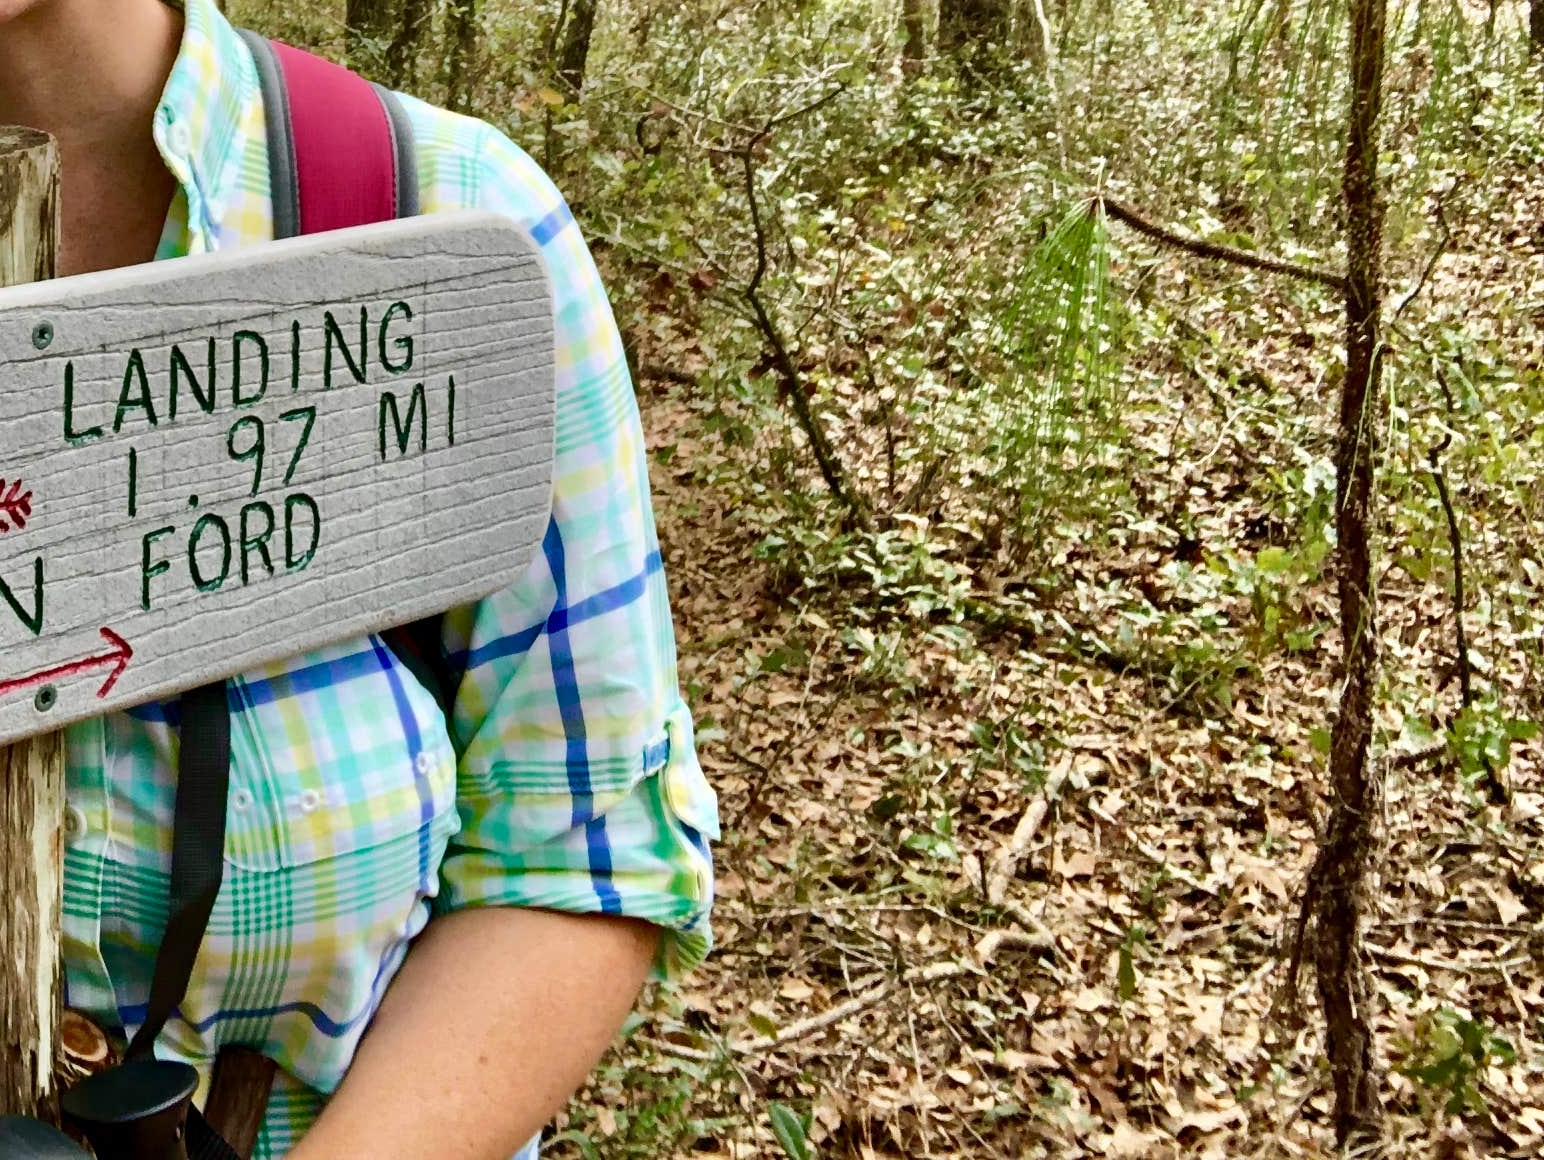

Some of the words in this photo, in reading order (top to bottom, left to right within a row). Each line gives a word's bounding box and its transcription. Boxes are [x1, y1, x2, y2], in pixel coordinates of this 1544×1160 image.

[61, 300, 416, 447] LANDING
[378, 374, 456, 462] MI
[140, 492, 322, 612] FORD
